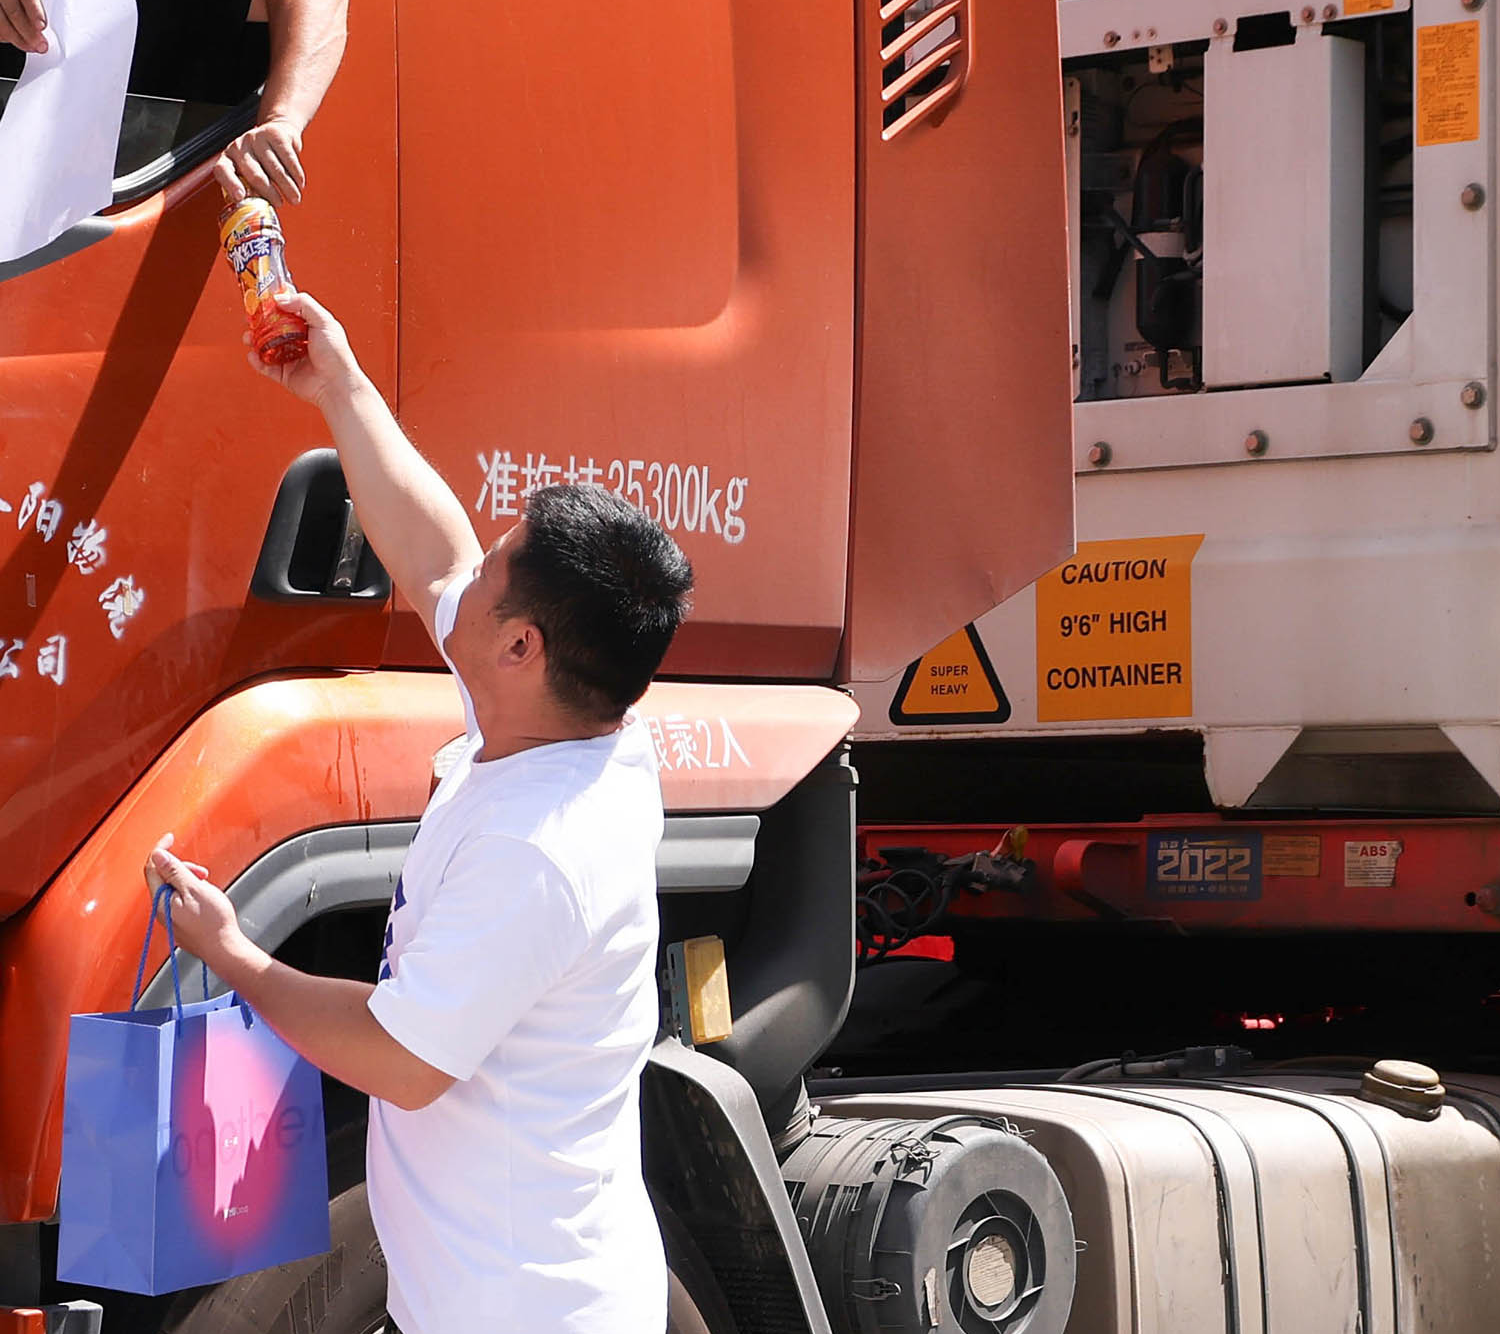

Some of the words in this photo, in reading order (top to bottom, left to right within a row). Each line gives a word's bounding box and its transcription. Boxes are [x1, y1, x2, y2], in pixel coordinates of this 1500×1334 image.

[1061, 559, 1167, 585] CAUTION
[1109, 610, 1167, 635] HIGH
[930, 665, 969, 679] SUPER
[1046, 662, 1183, 691] CONTAINER
[930, 683, 969, 697] HEAVY
[1359, 845, 1388, 857] ABS
[1157, 848, 1250, 881] 2022
